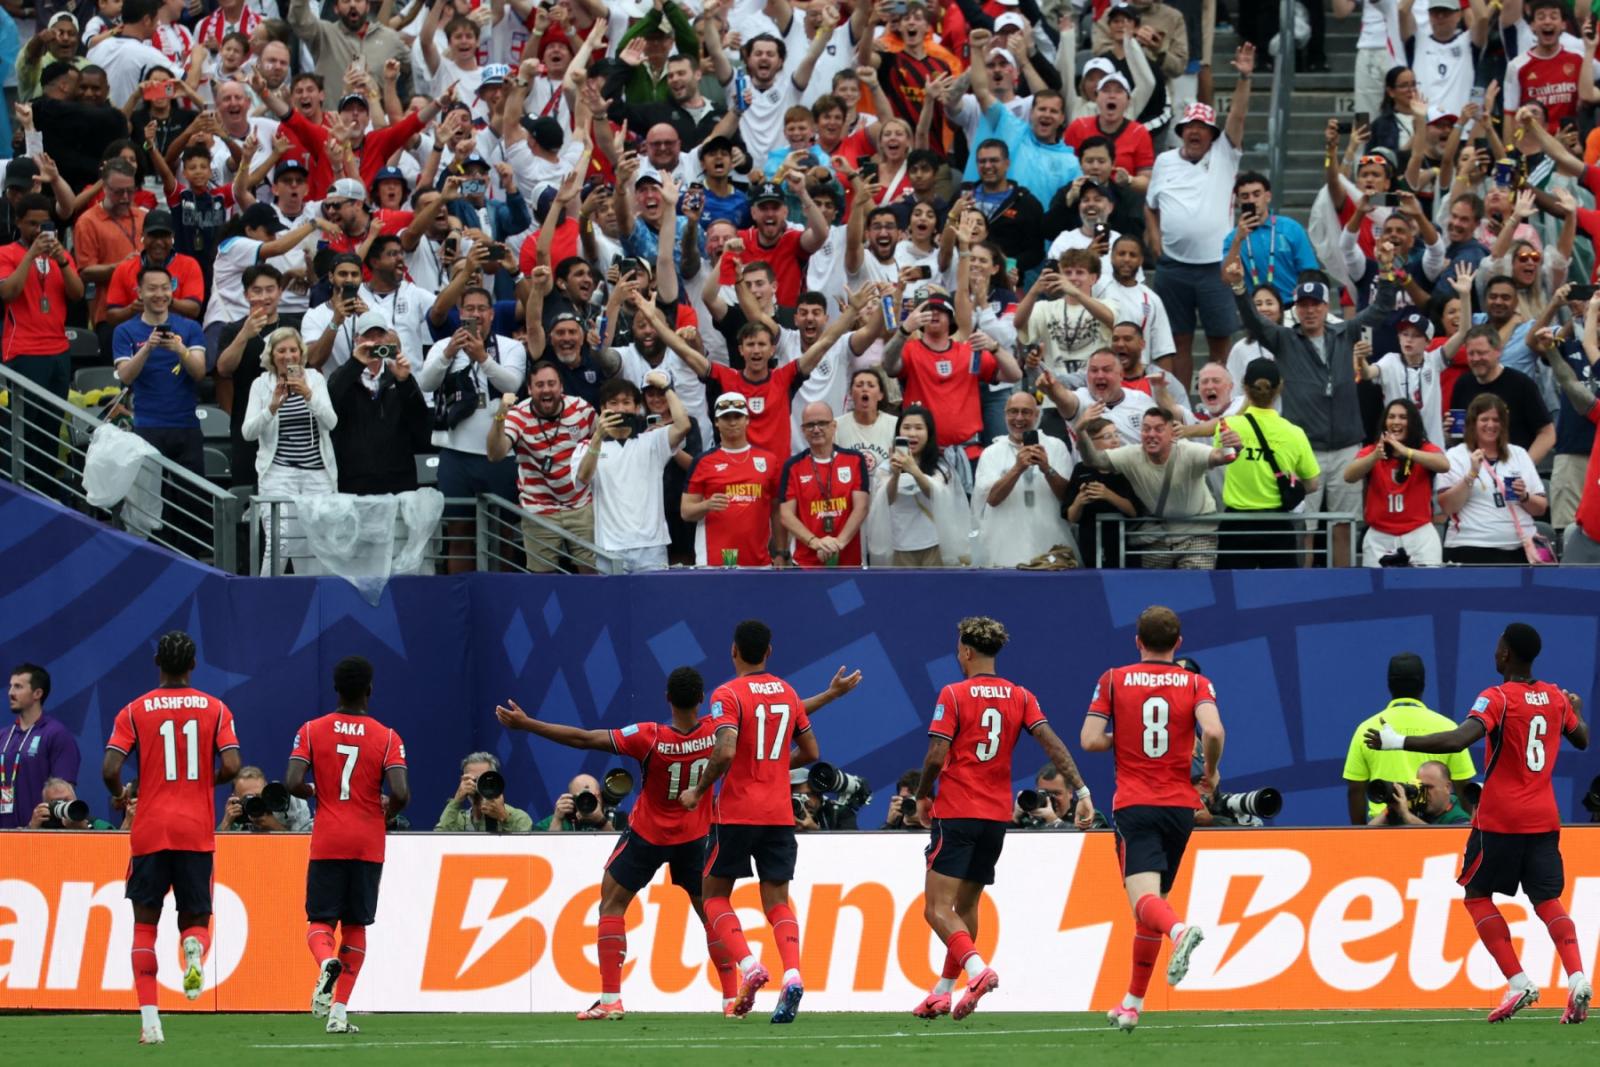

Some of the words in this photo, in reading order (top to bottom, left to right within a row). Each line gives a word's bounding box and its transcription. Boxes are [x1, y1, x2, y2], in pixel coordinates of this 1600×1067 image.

[1339, 98, 1355, 113] 12
[725, 482, 763, 499] AUSTIN
[1387, 493, 1405, 513] 10
[748, 681, 785, 695] ROGERS
[1123, 671, 1190, 688] ANDERSON
[970, 685, 1012, 699] O'REILLY
[144, 694, 209, 714] RASHFORD
[333, 720, 365, 738] SAKA
[755, 703, 790, 761] 17
[976, 707, 1002, 762] 3
[1142, 696, 1169, 758] 8
[160, 719, 199, 781] 11
[1526, 715, 1548, 772] 6
[336, 744, 360, 800] 7
